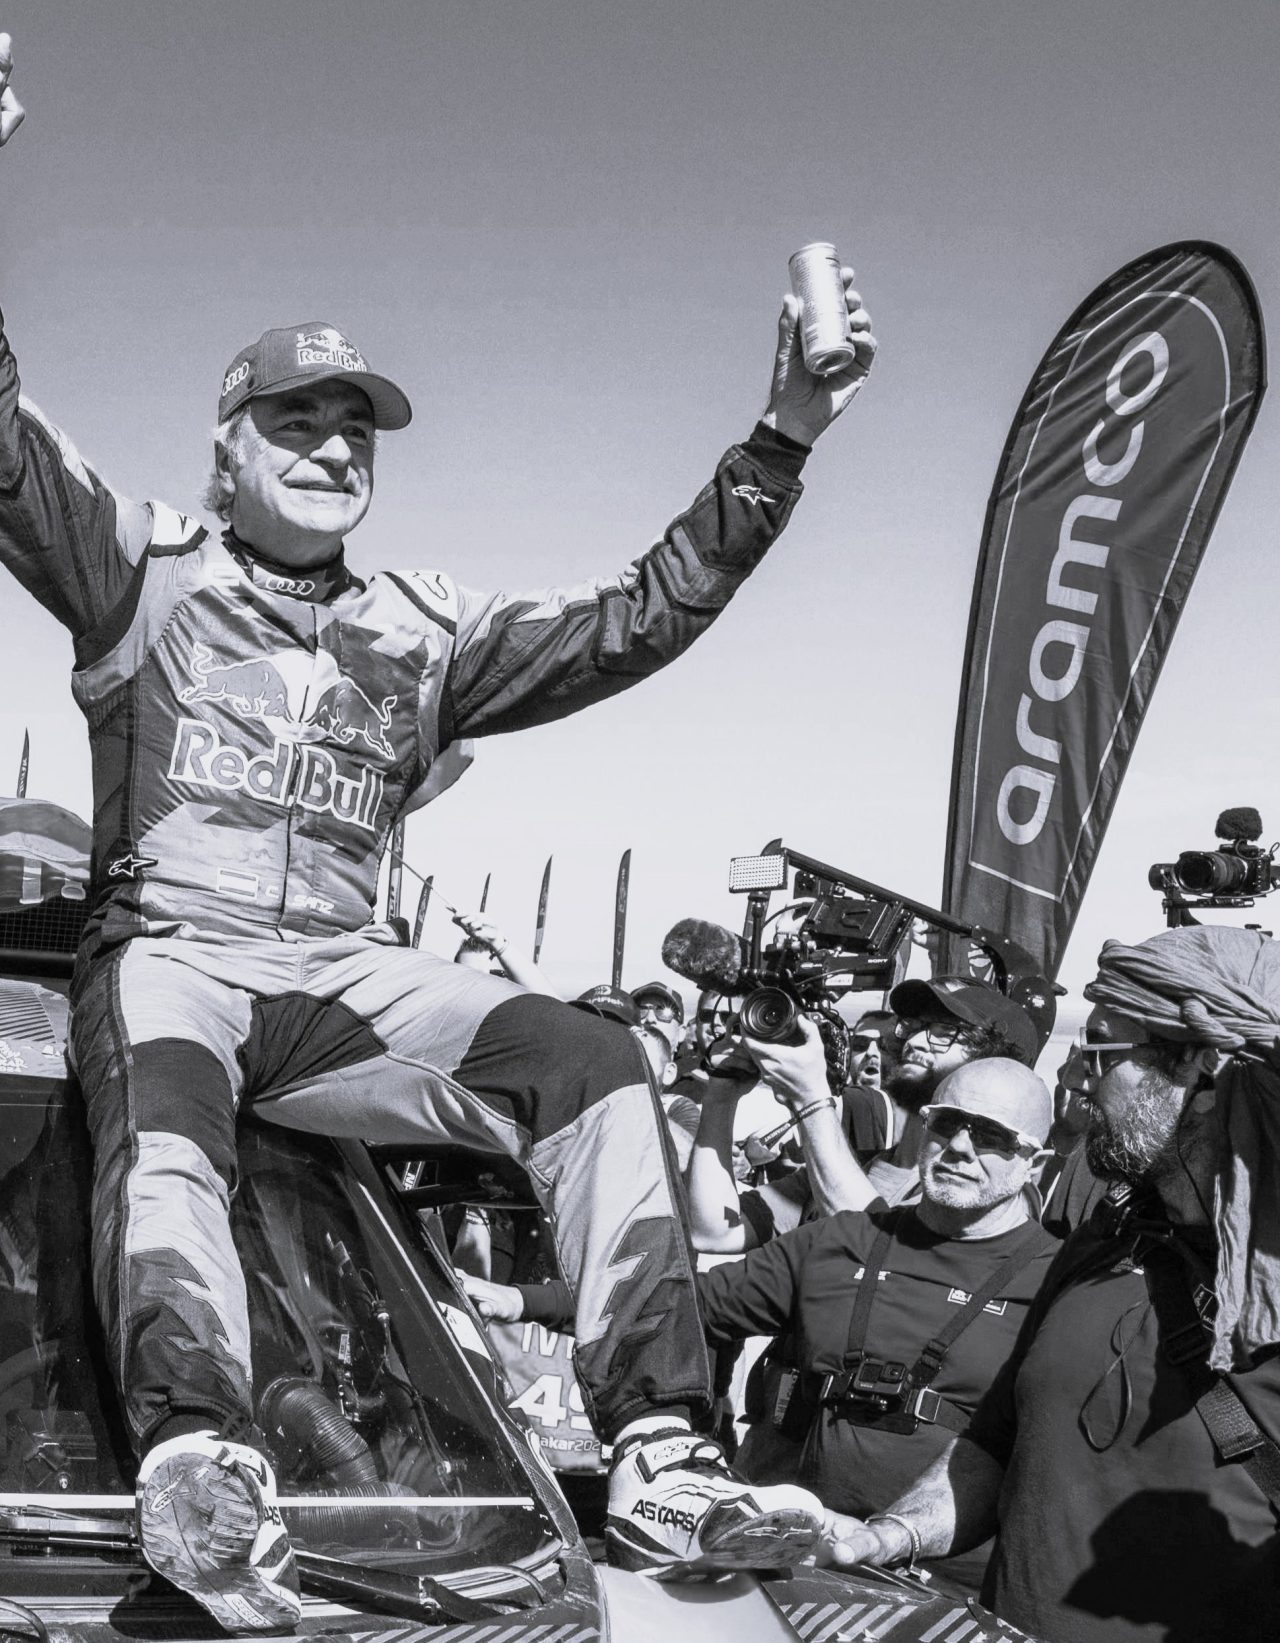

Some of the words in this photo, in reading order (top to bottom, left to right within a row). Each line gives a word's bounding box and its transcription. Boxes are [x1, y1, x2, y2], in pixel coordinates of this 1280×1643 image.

[297, 349, 339, 366] Red
[997, 331, 1170, 846] aramco
[167, 717, 297, 805] Red
[293, 744, 387, 831] Bull
[539, 1436, 602, 1451] akar202
[630, 1499, 696, 1533] ASTARS
